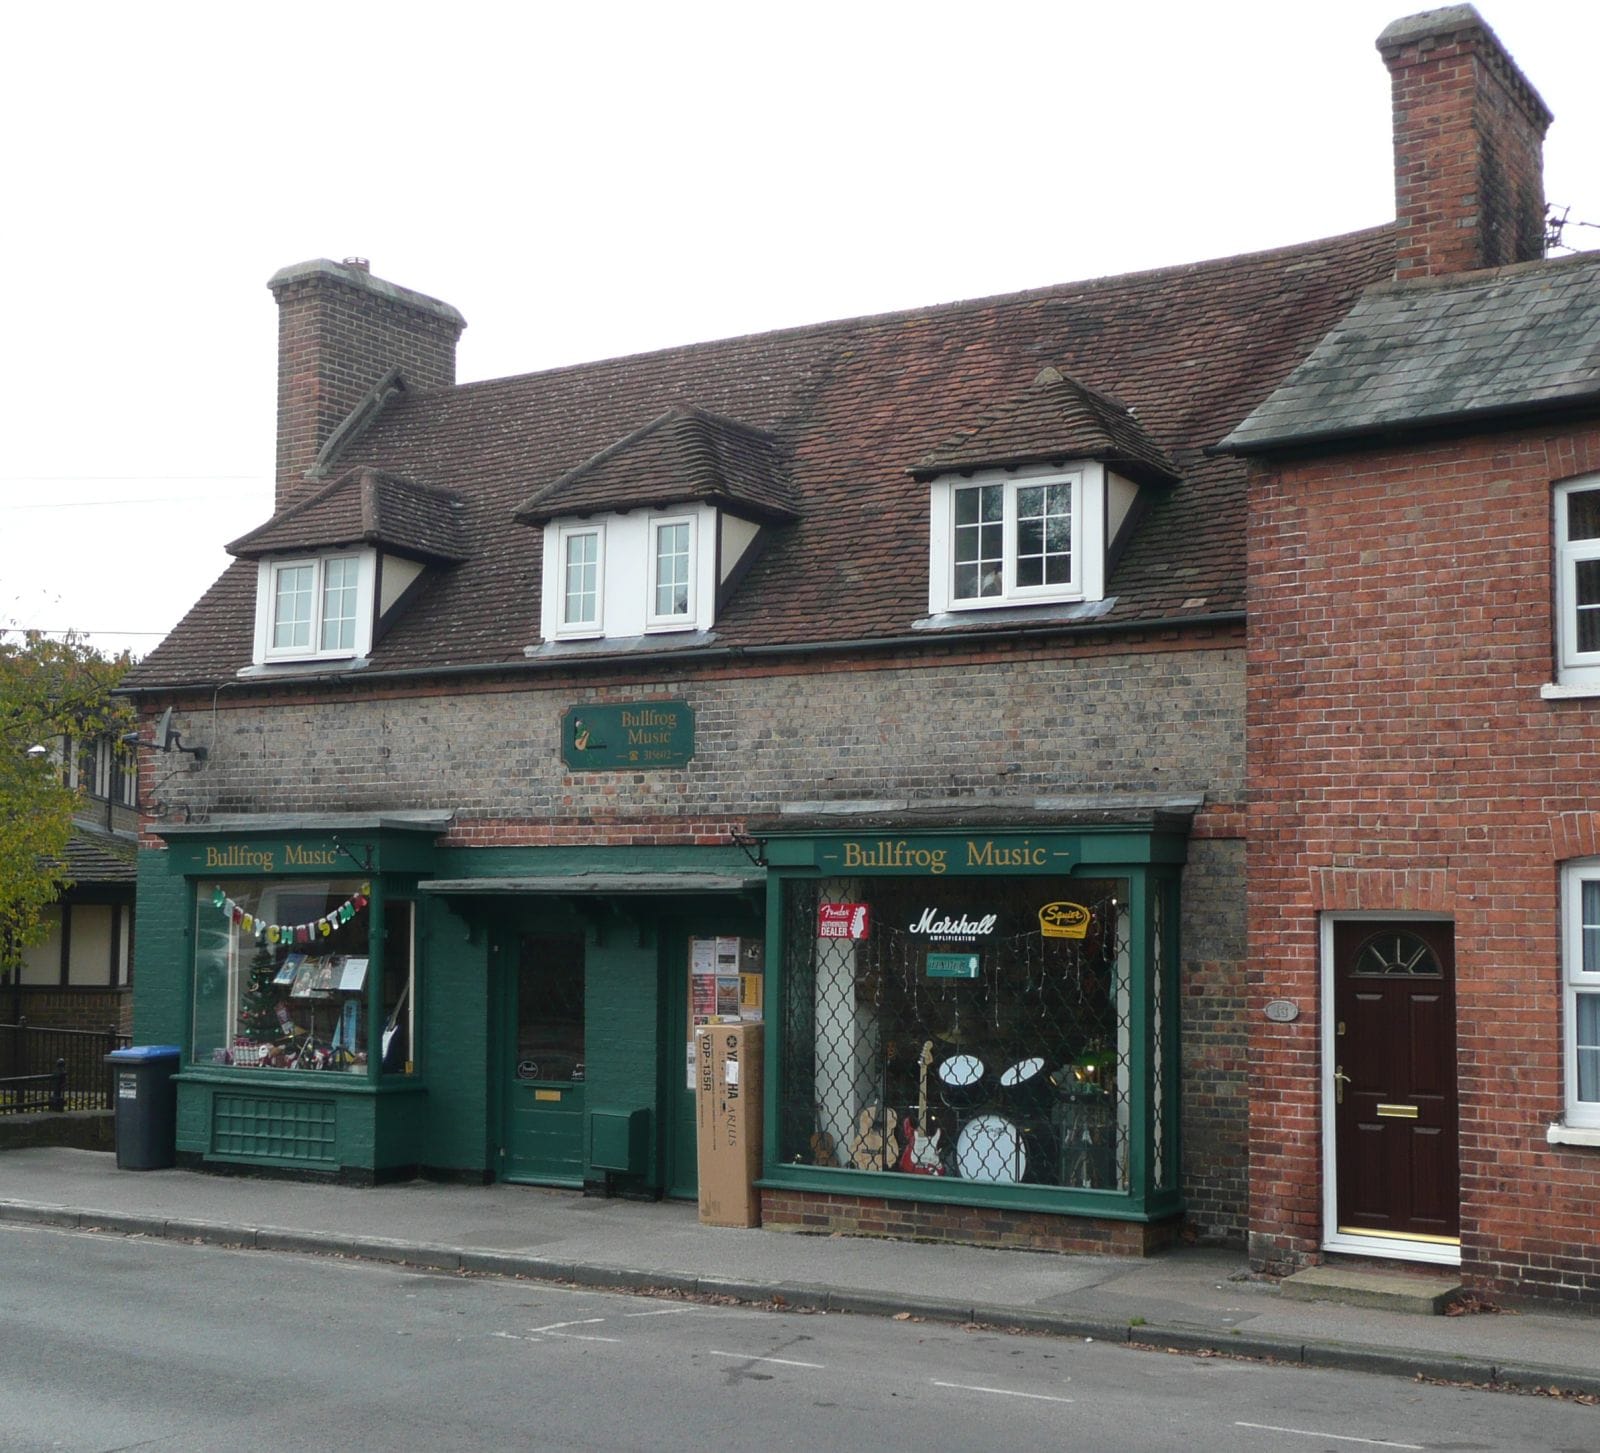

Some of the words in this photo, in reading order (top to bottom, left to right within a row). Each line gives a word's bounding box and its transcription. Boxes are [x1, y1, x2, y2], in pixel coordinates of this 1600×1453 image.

[622, 709, 677, 729] Bullfrog
[628, 729, 672, 745] Music
[205, 844, 274, 872] Bullfrog
[284, 843, 337, 865] Music
[843, 840, 948, 874] Bullfrog
[966, 840, 1047, 867] Music
[820, 904, 850, 919] Fender
[909, 907, 998, 935] Marshall
[1044, 905, 1084, 926] Squier
[821, 926, 849, 937] DEALER
[726, 1050, 739, 1100] YAHA
